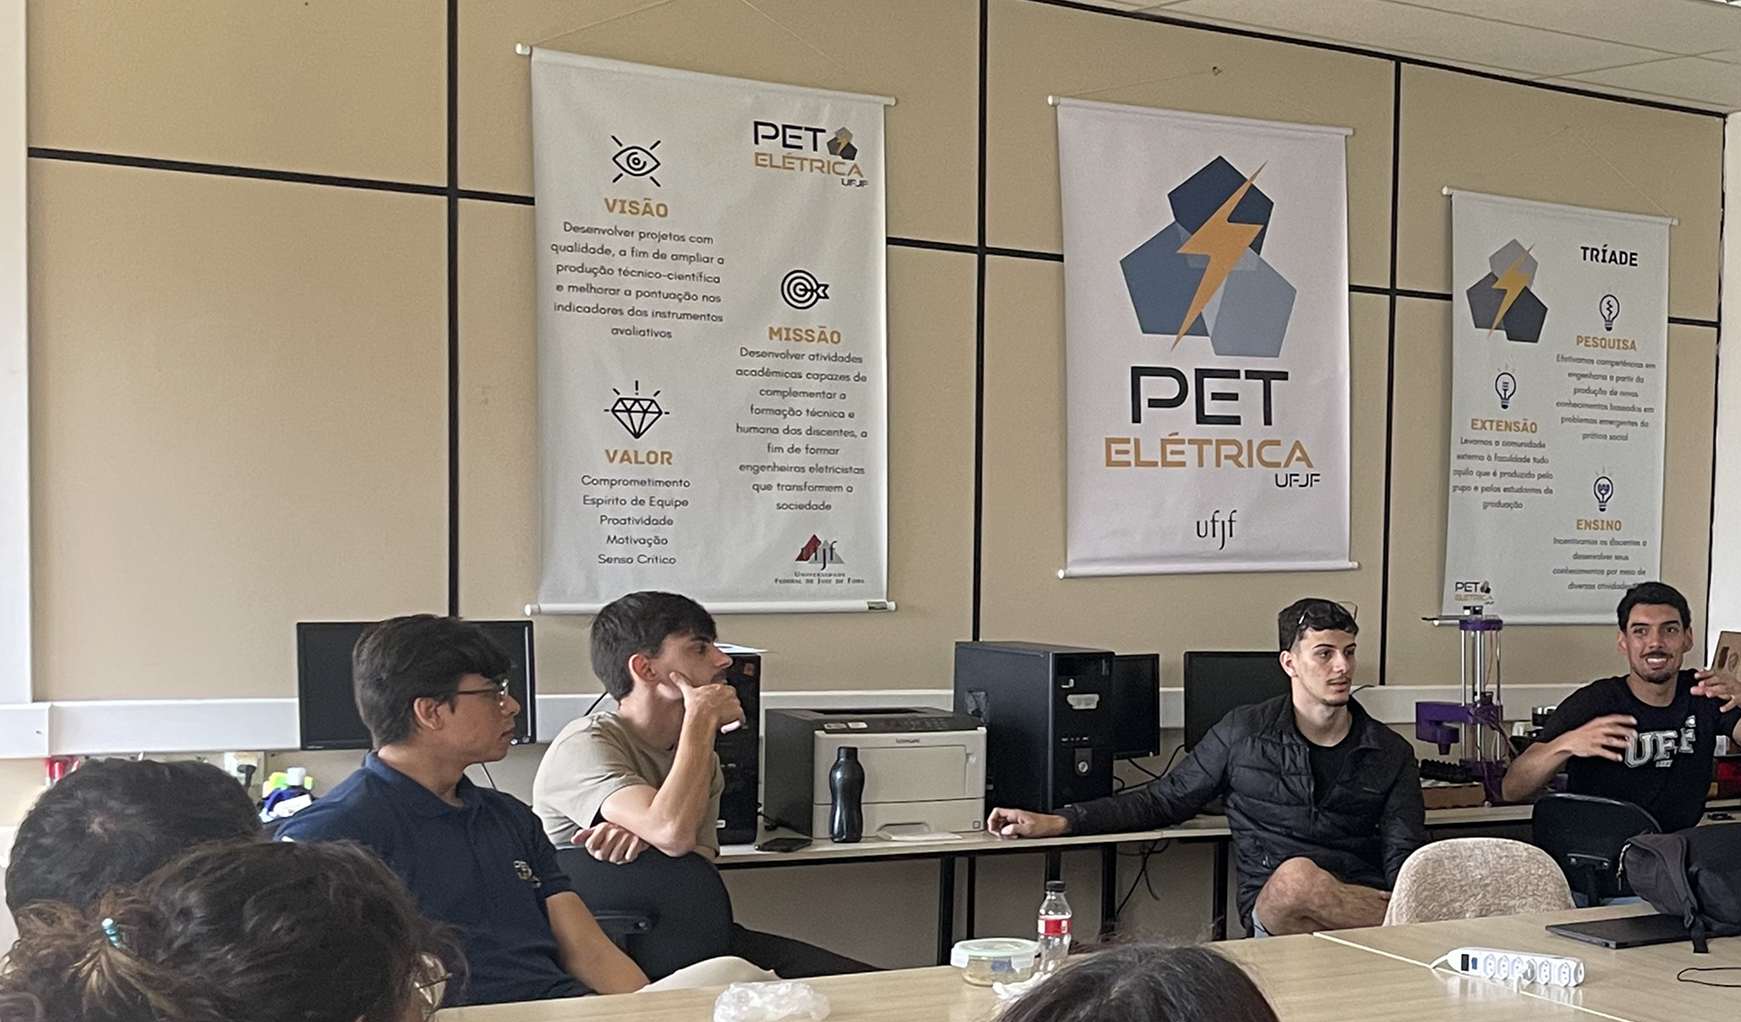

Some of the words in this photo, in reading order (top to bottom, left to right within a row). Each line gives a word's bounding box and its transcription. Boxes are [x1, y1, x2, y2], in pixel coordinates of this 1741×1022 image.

[753, 120, 826, 151] PET
[754, 151, 864, 178] ELÉTRICA
[604, 197, 669, 218] VISÃO
[564, 221, 635, 238] Desenvolver
[638, 230, 686, 244] projetos
[689, 236, 714, 245] com
[550, 242, 616, 258] qualidade,
[631, 246, 649, 259] fim
[652, 249, 667, 260] de
[670, 251, 715, 265] ampliar
[1580, 244, 1639, 267] TRÍADE
[556, 263, 615, 277] produção
[618, 266, 721, 284] técnico-científica
[567, 282, 621, 296] melhorar
[635, 288, 698, 304] pontuação
[702, 294, 722, 303] nos
[553, 301, 624, 316] indicadores
[627, 306, 648, 317] dos
[651, 309, 724, 323] instrumentos
[611, 325, 673, 339] avaliativos
[768, 325, 842, 345] MISSÃO
[1576, 335, 1637, 351] PESQUISA
[740, 346, 806, 361] Desenvolver
[808, 352, 863, 364] atividades
[735, 366, 803, 379] acadêmicas
[805, 371, 851, 383] capazes
[853, 371, 868, 383] de
[759, 387, 837, 400] complementar
[1130, 365, 1289, 426] PET
[750, 403, 803, 419] formação
[805, 407, 846, 419] técnica
[735, 422, 779, 435] humana
[782, 424, 803, 436] dos
[805, 425, 858, 439] discentes,
[1470, 418, 1538, 434] EXTENSÃO
[767, 442, 784, 454] fim
[787, 443, 802, 454] de
[804, 443, 840, 455] formar
[1104, 431, 1314, 468] ELÉTRICA
[604, 449, 673, 466] VALOR
[739, 461, 806, 475] engenheiros
[808, 463, 866, 475] eletricistas
[581, 475, 691, 489] Comprometimento
[752, 482, 773, 494] que
[776, 481, 844, 493] transformem
[1274, 473, 1321, 488] UFJF
[582, 494, 627, 508] Espírito
[630, 495, 646, 507] de
[649, 495, 689, 510] Equipe
[776, 499, 832, 511] sociedade
[600, 514, 674, 526] Proatividade
[1576, 519, 1622, 531] ENSINO
[1196, 509, 1237, 550] ufjf
[606, 535, 668, 548] Motivação
[598, 553, 634, 565] Senso
[636, 554, 677, 565] Crítico
[1455, 581, 1481, 593] PET
